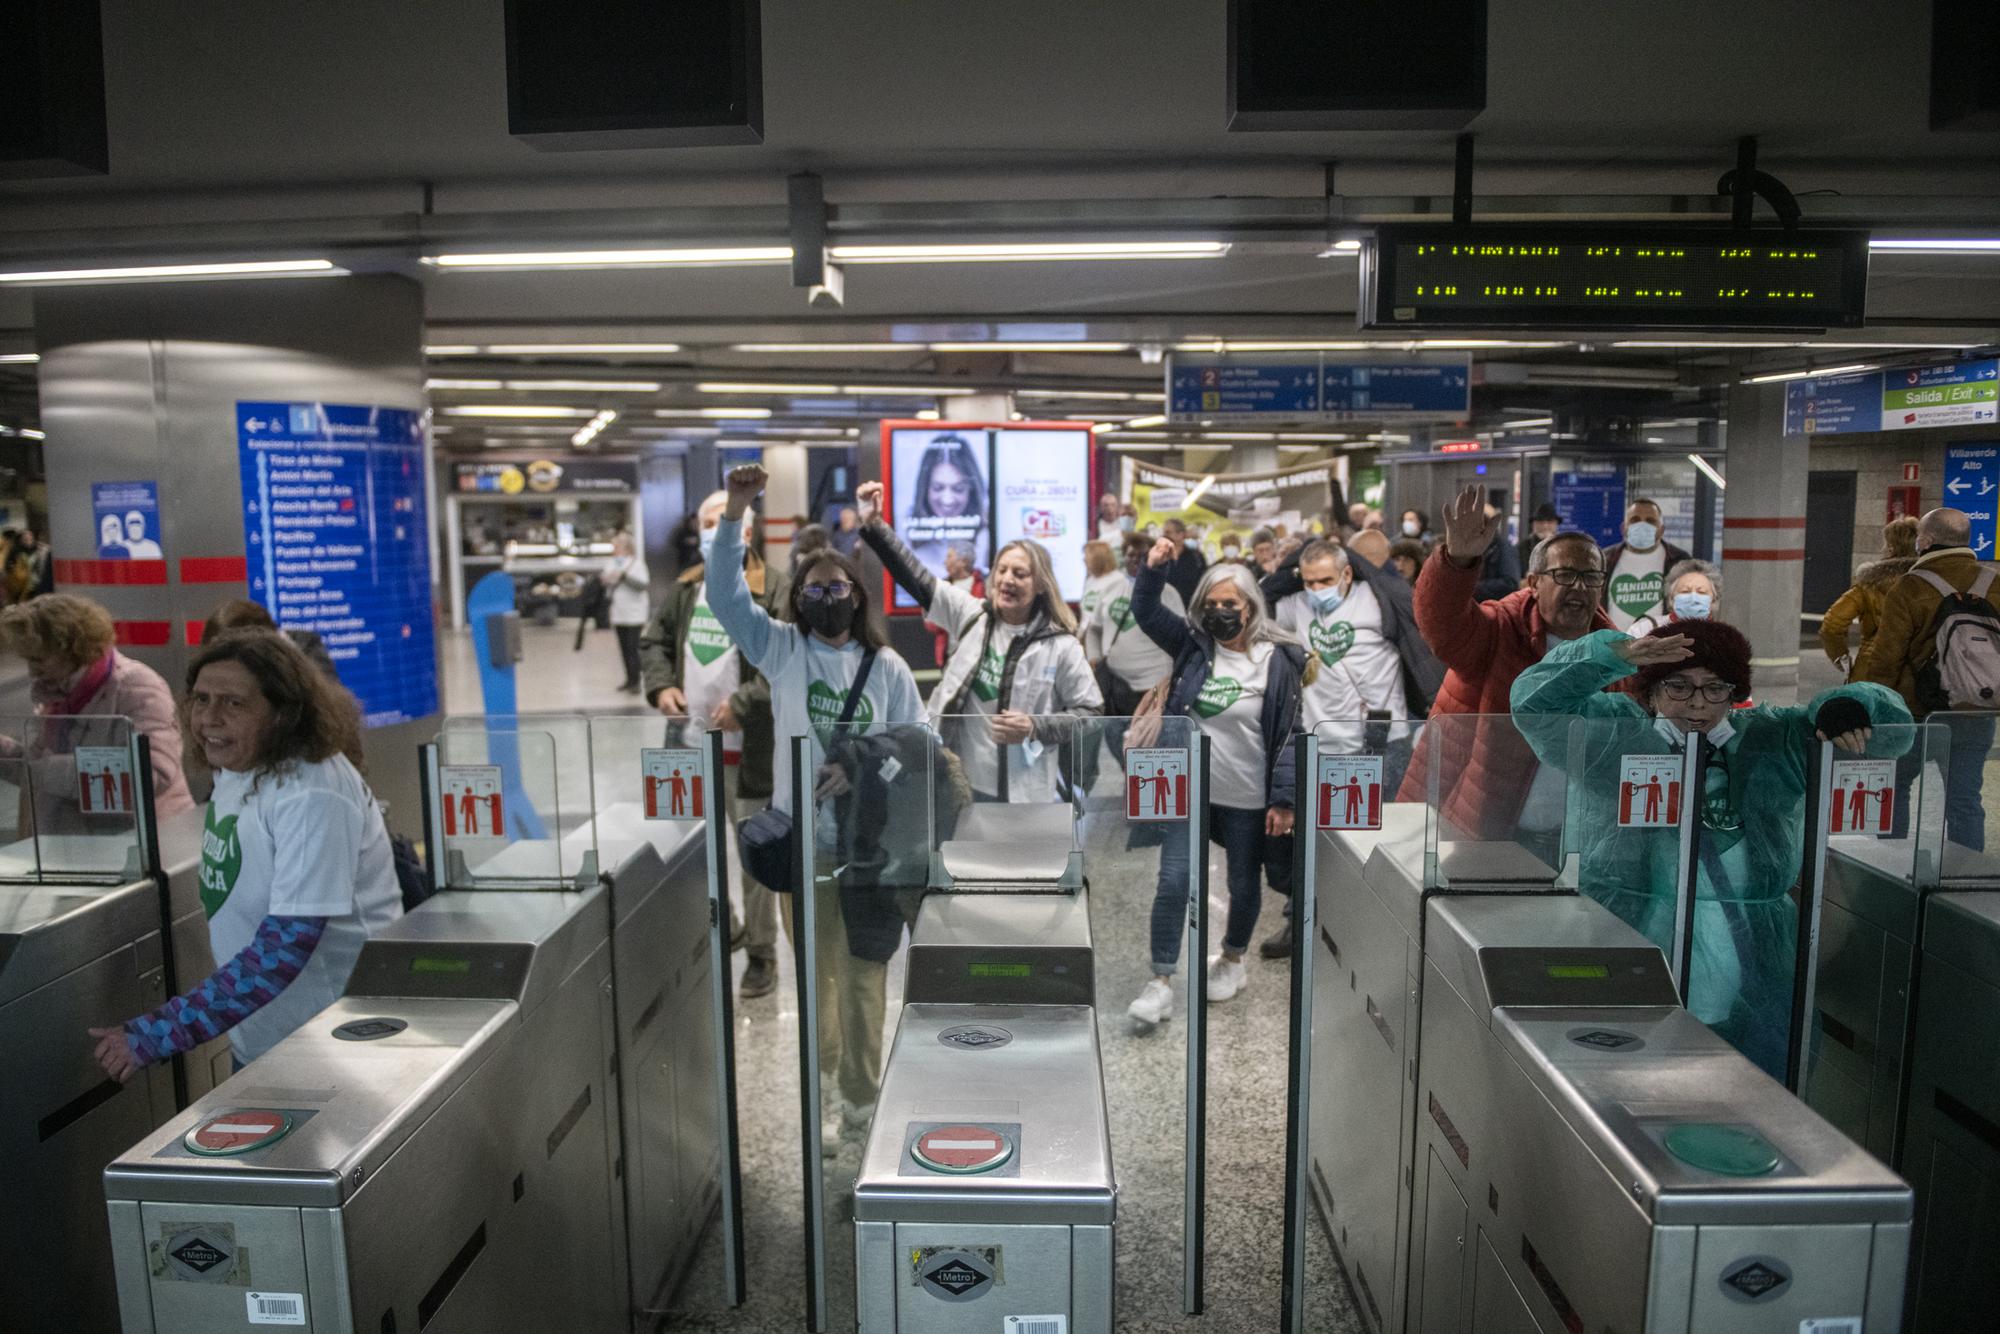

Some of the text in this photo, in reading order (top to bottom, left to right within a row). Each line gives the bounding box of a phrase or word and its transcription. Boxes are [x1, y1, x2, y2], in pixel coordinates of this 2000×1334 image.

[1205, 372, 1215, 384] 2
[1906, 387, 1973, 404] Salida / Exit
[1808, 403, 1814, 413] 2
[1807, 420, 1813, 431] 3
[1950, 449, 1997, 458] Villaverde
[1962, 461, 1983, 470] Alto
[1616, 580, 1662, 593] SANIDAD
[186, 1251, 213, 1261] Metro
[942, 1272, 971, 1282] Metro
